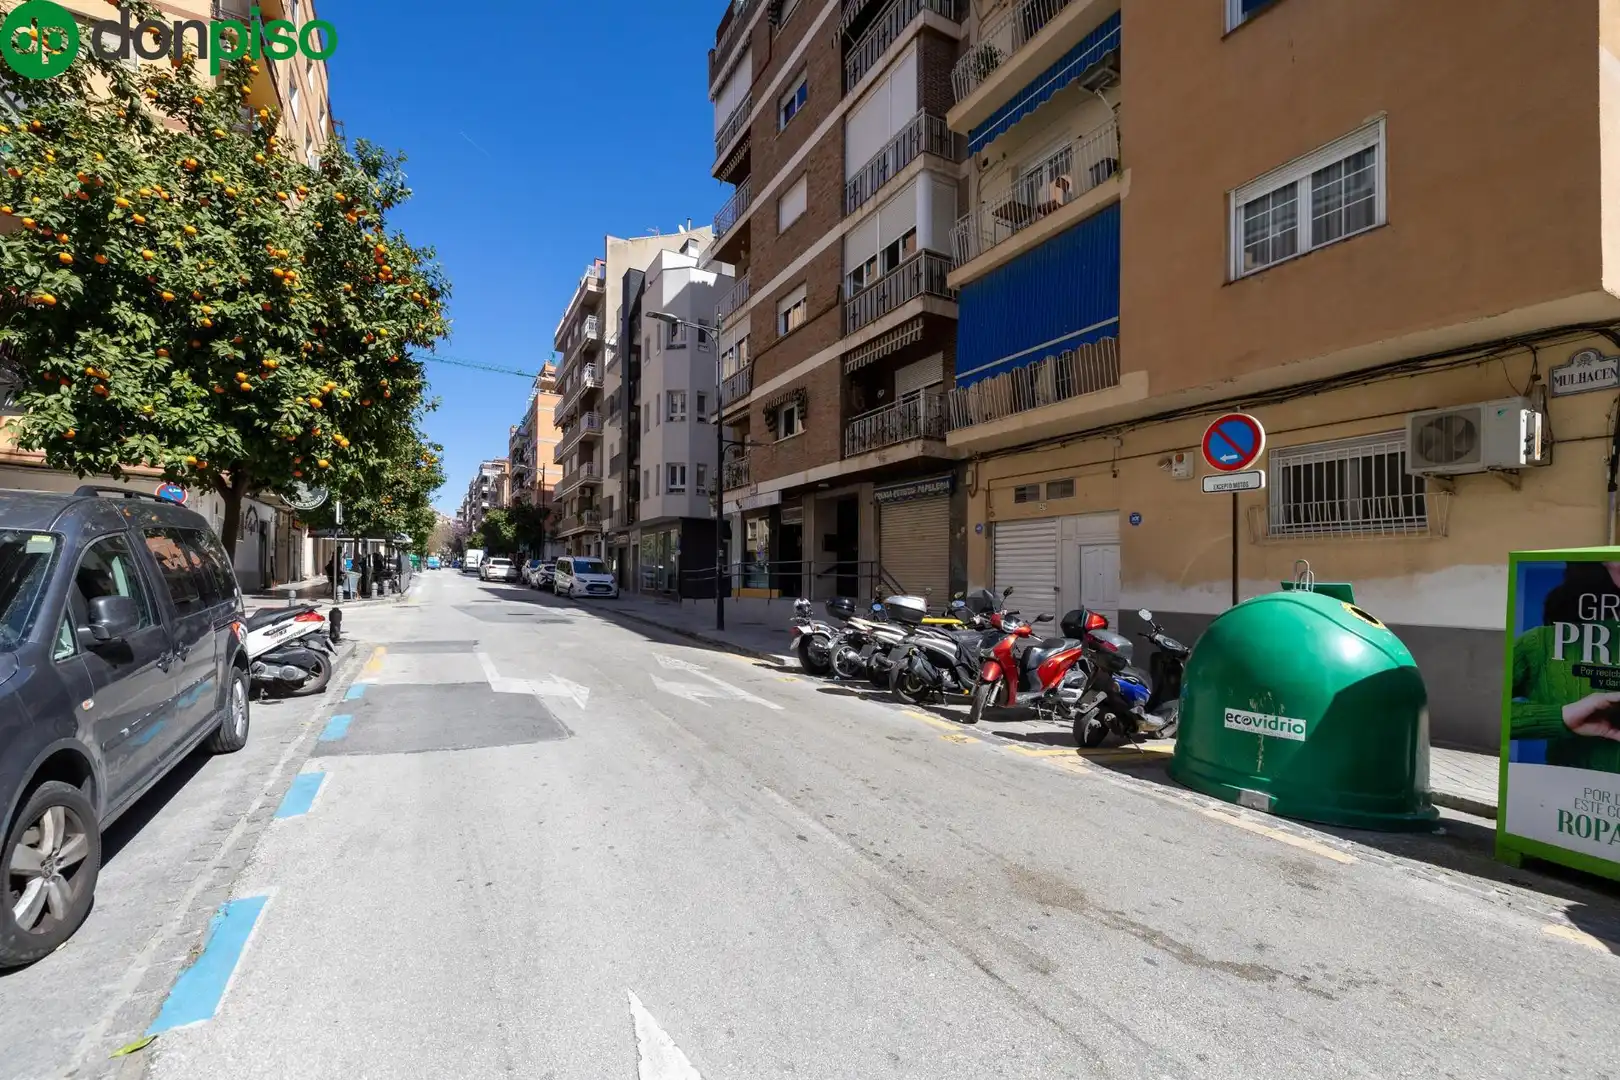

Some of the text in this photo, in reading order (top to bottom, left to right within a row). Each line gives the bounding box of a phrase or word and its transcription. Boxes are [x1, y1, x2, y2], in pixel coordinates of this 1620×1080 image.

[1213, 480, 1250, 490] EXCEPTO MOTOS
[1552, 621, 1620, 666] PR
[1580, 666, 1620, 678] Por recicl
[1225, 711, 1304, 734] ecovidrio
[1583, 787, 1611, 803] POR
[1574, 797, 1604, 814] ESTE
